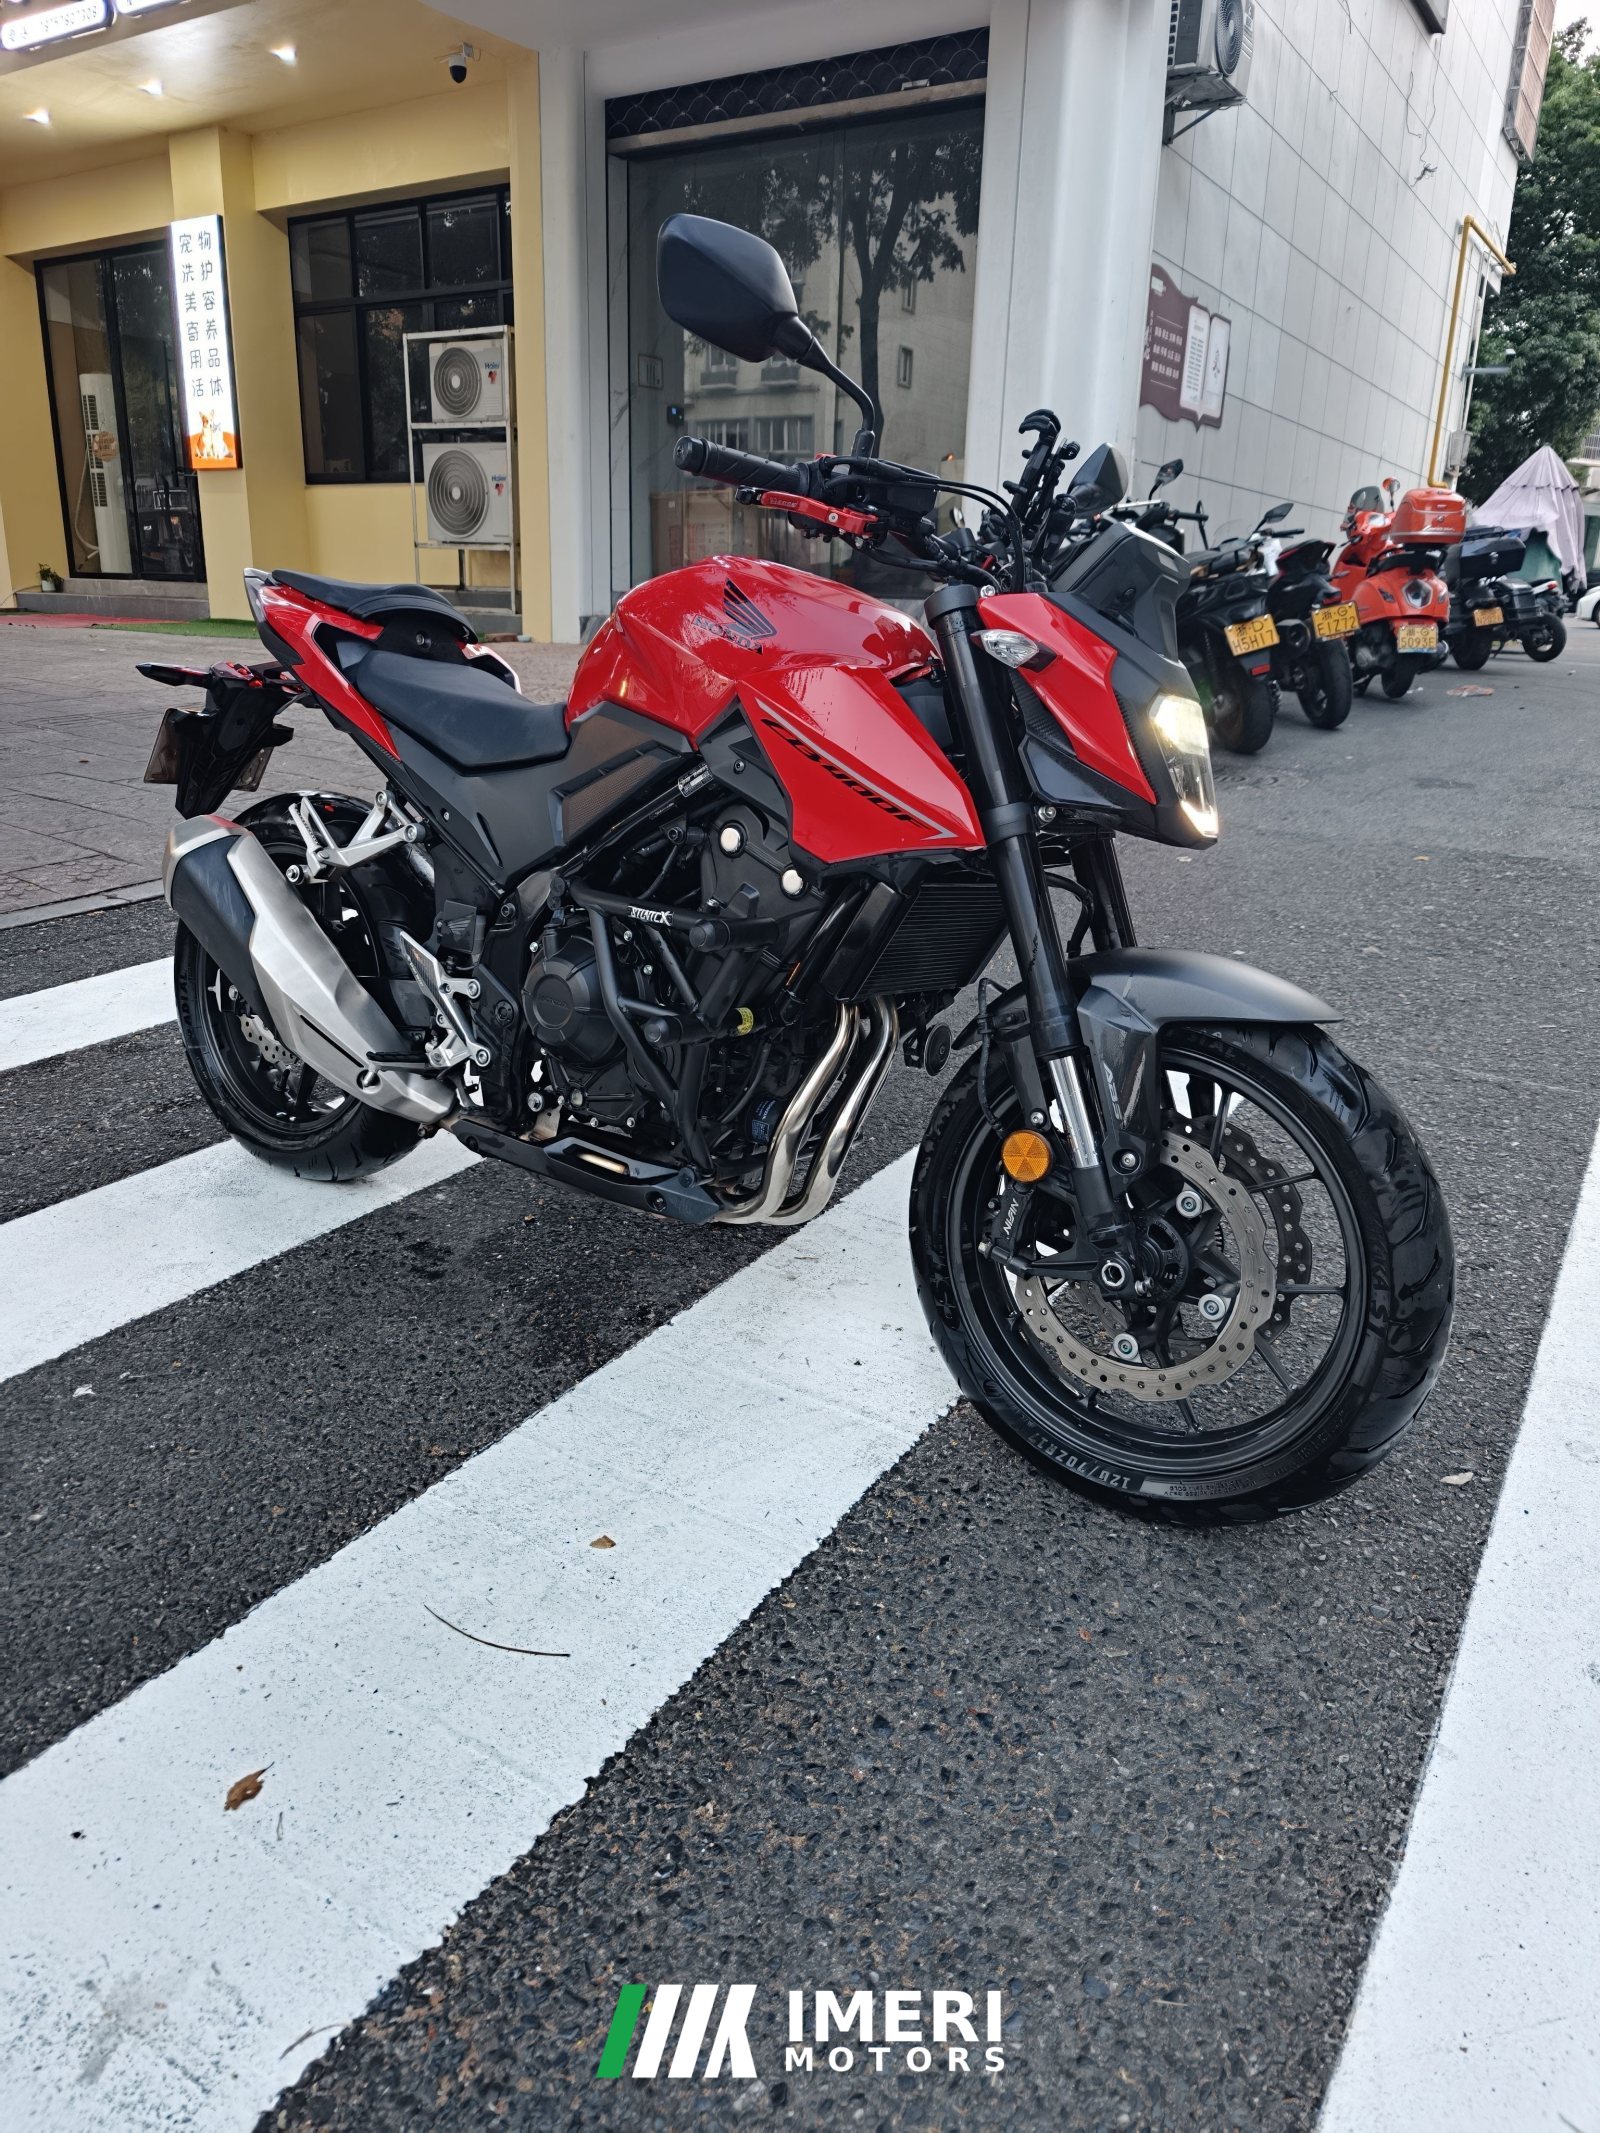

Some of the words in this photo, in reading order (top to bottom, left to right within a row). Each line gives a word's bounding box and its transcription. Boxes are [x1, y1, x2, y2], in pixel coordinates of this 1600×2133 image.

[178, 231, 212, 254] 宠物
[181, 260, 214, 283] 洗护
[184, 291, 216, 313] 美容
[186, 319, 218, 342] 寄养
[190, 348, 221, 370] 用品
[191, 377, 224, 398] 活体
